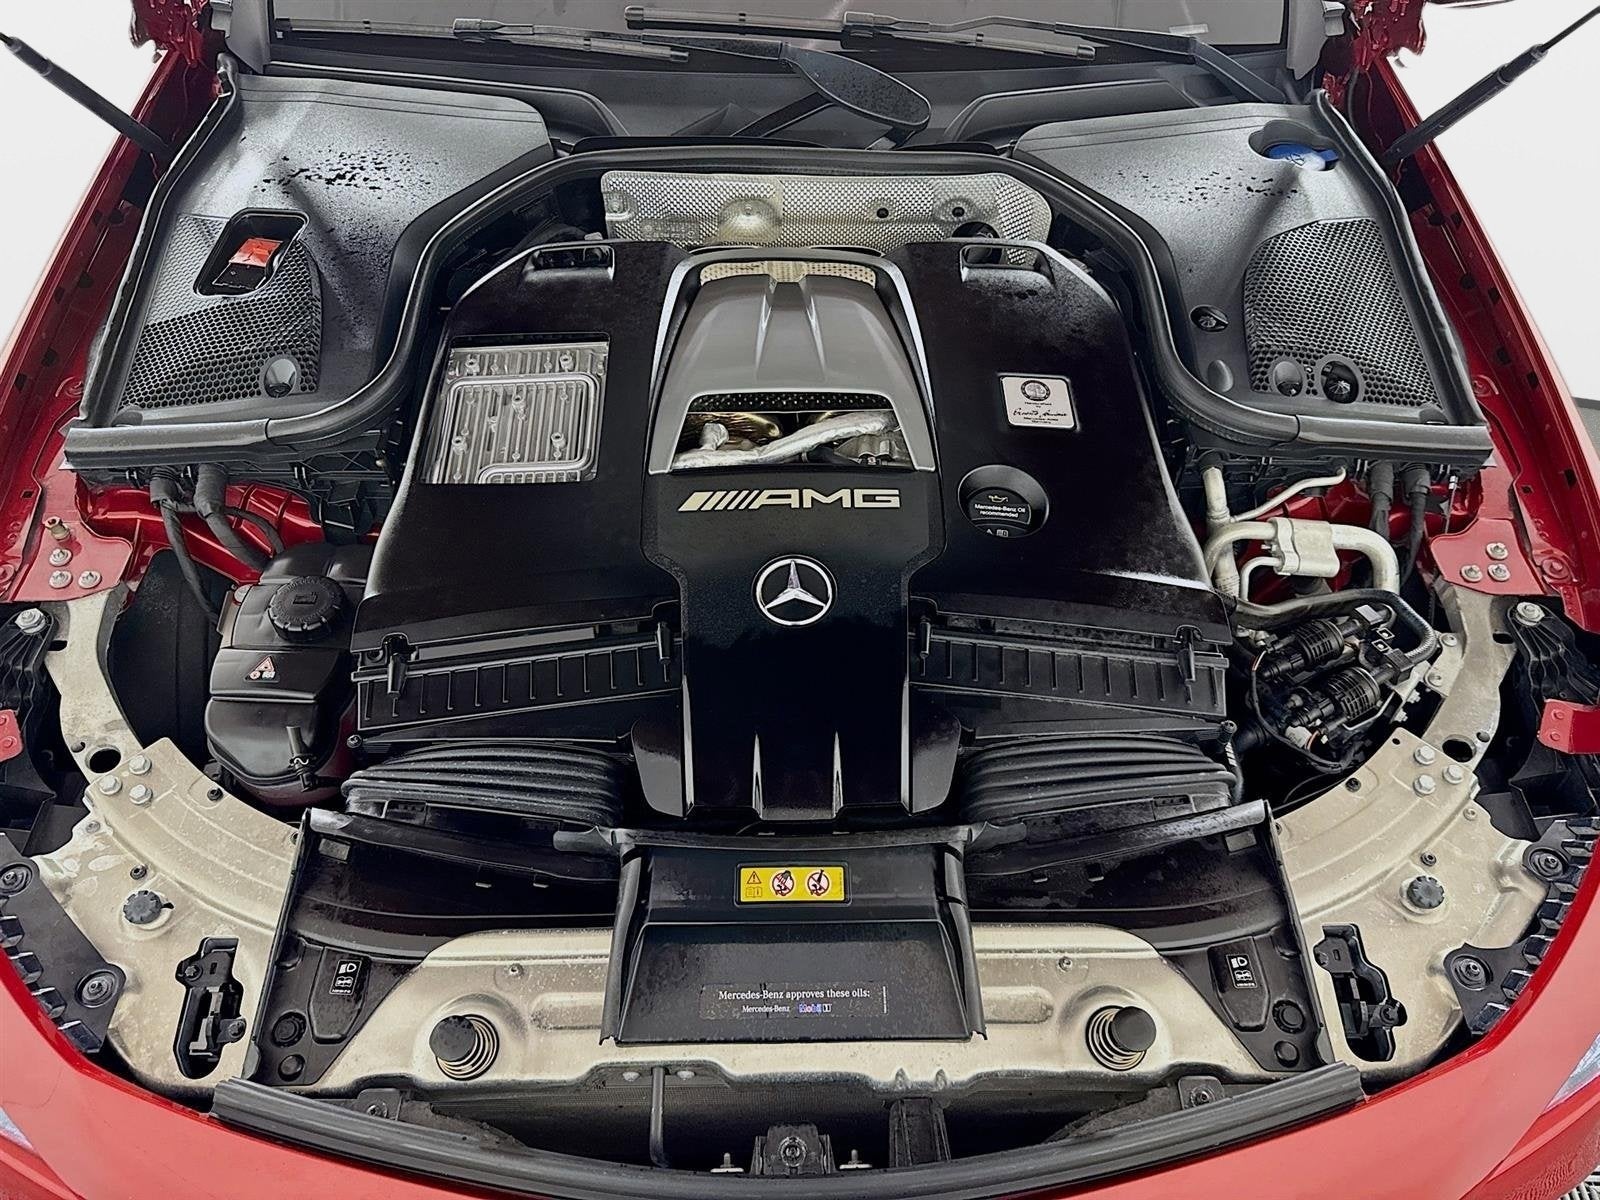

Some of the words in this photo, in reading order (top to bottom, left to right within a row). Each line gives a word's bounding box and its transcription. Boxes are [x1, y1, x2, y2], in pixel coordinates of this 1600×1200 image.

[749, 488, 901, 510] AMG
[974, 503, 1017, 512] Mercedes-Benz
[979, 510, 1019, 518] recommended
[718, 989, 784, 1000] Mercedes-Benz
[785, 990, 825, 1002] approves
[826, 988, 850, 998] these
[742, 1004, 790, 1013] Mercedes-Benz
